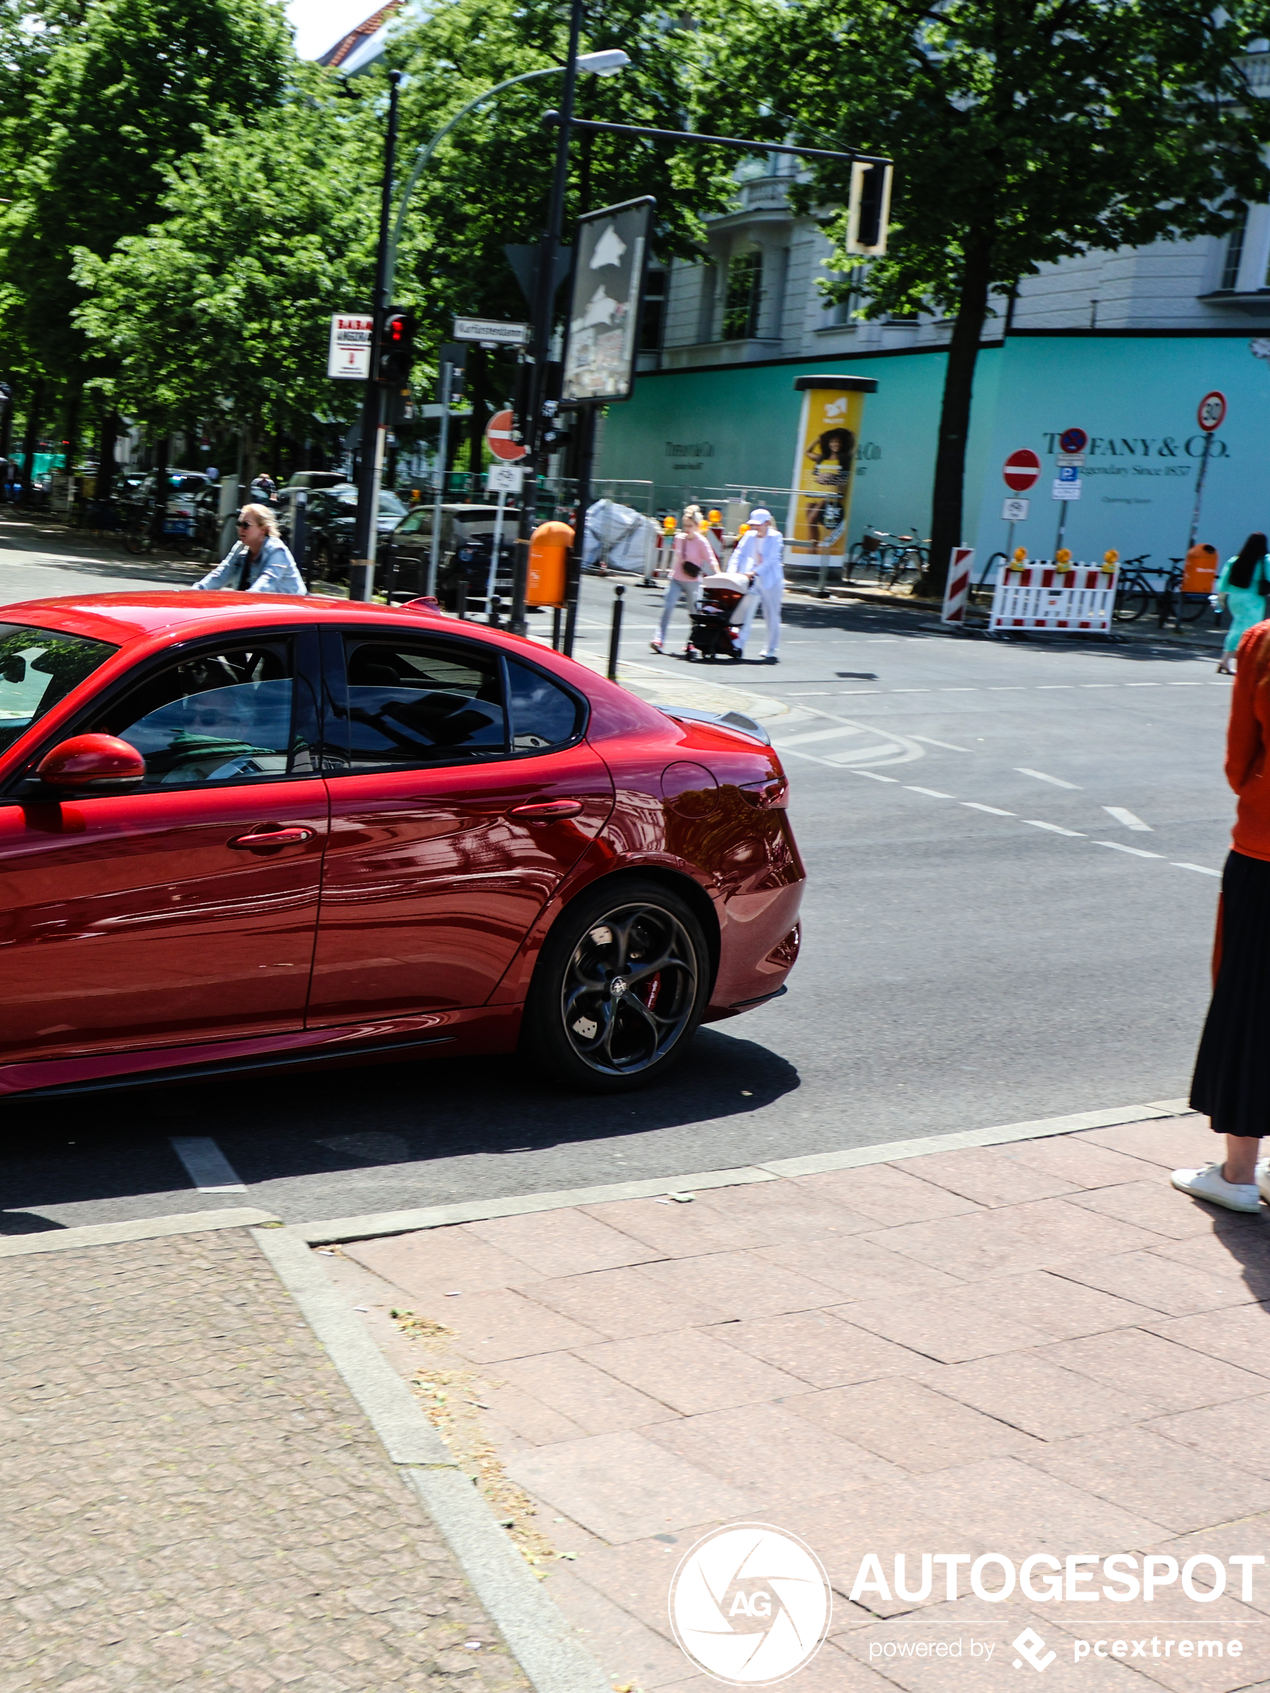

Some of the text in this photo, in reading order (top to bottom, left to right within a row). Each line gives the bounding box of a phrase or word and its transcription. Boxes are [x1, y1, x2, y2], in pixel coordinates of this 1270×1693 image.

[1202, 402, 1222, 421] 30
[1043, 431, 1154, 457] TFANY
[1158, 436, 1179, 457] &
